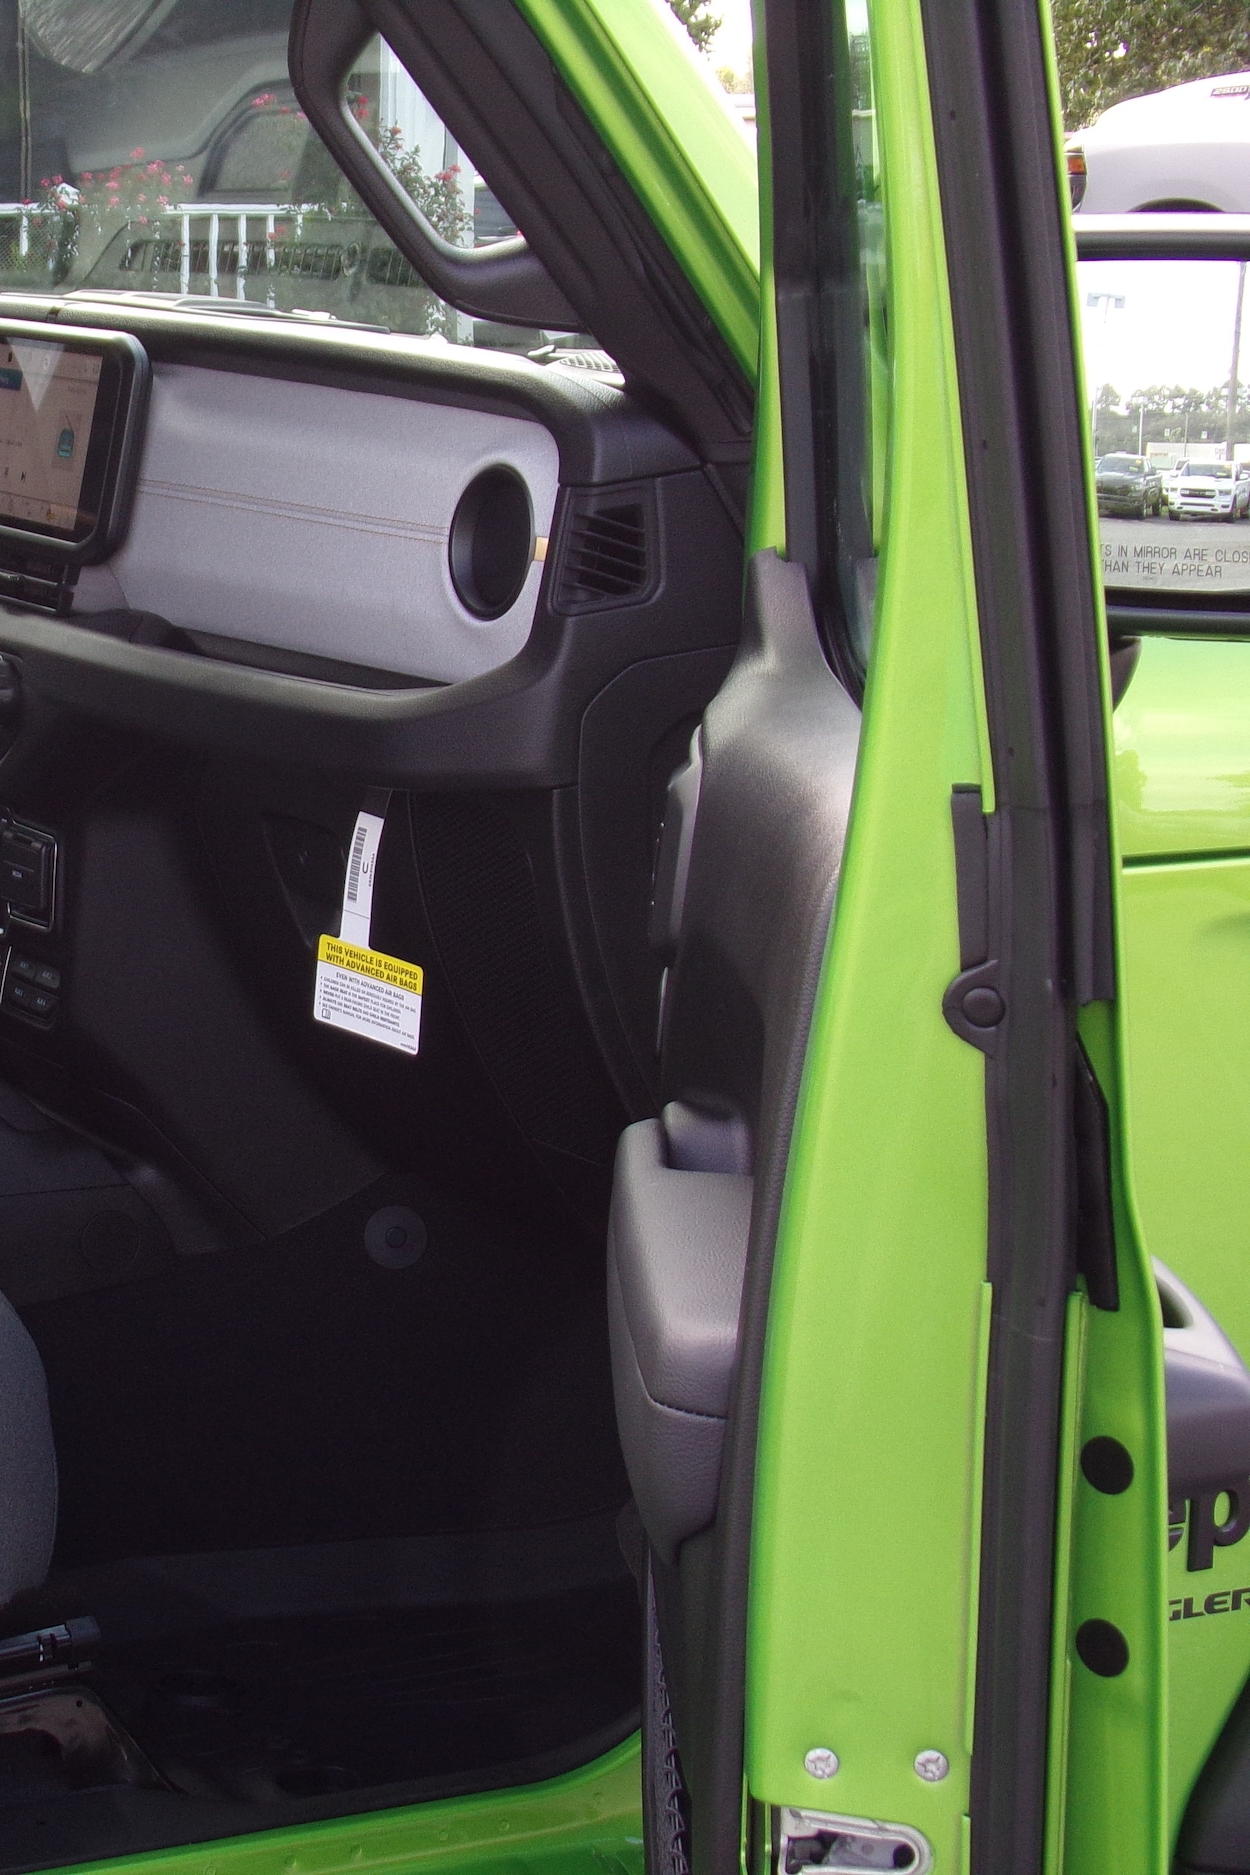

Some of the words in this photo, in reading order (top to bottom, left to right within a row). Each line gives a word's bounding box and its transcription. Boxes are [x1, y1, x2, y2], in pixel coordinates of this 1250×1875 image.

[1117, 545, 1128, 558] IN
[1133, 545, 1177, 560] MIRROR
[1183, 547, 1209, 562] ARE
[1215, 549, 1250, 564] CLOS
[1101, 559, 1128, 572] HAN
[1135, 561, 1165, 575] THEY
[1171, 563, 1223, 578] APPEAR
[326, 941, 343, 954] THIS
[344, 947, 374, 965] VEHICLE
[375, 958, 383, 968] IS
[383, 961, 418, 980] EQUIPPED
[326, 952, 345, 966] WITH
[345, 959, 385, 979] ADVANCED
[386, 973, 398, 985] AIR
[399, 977, 417, 991] BAGS
[360, 979, 384, 993] ADVANCED
